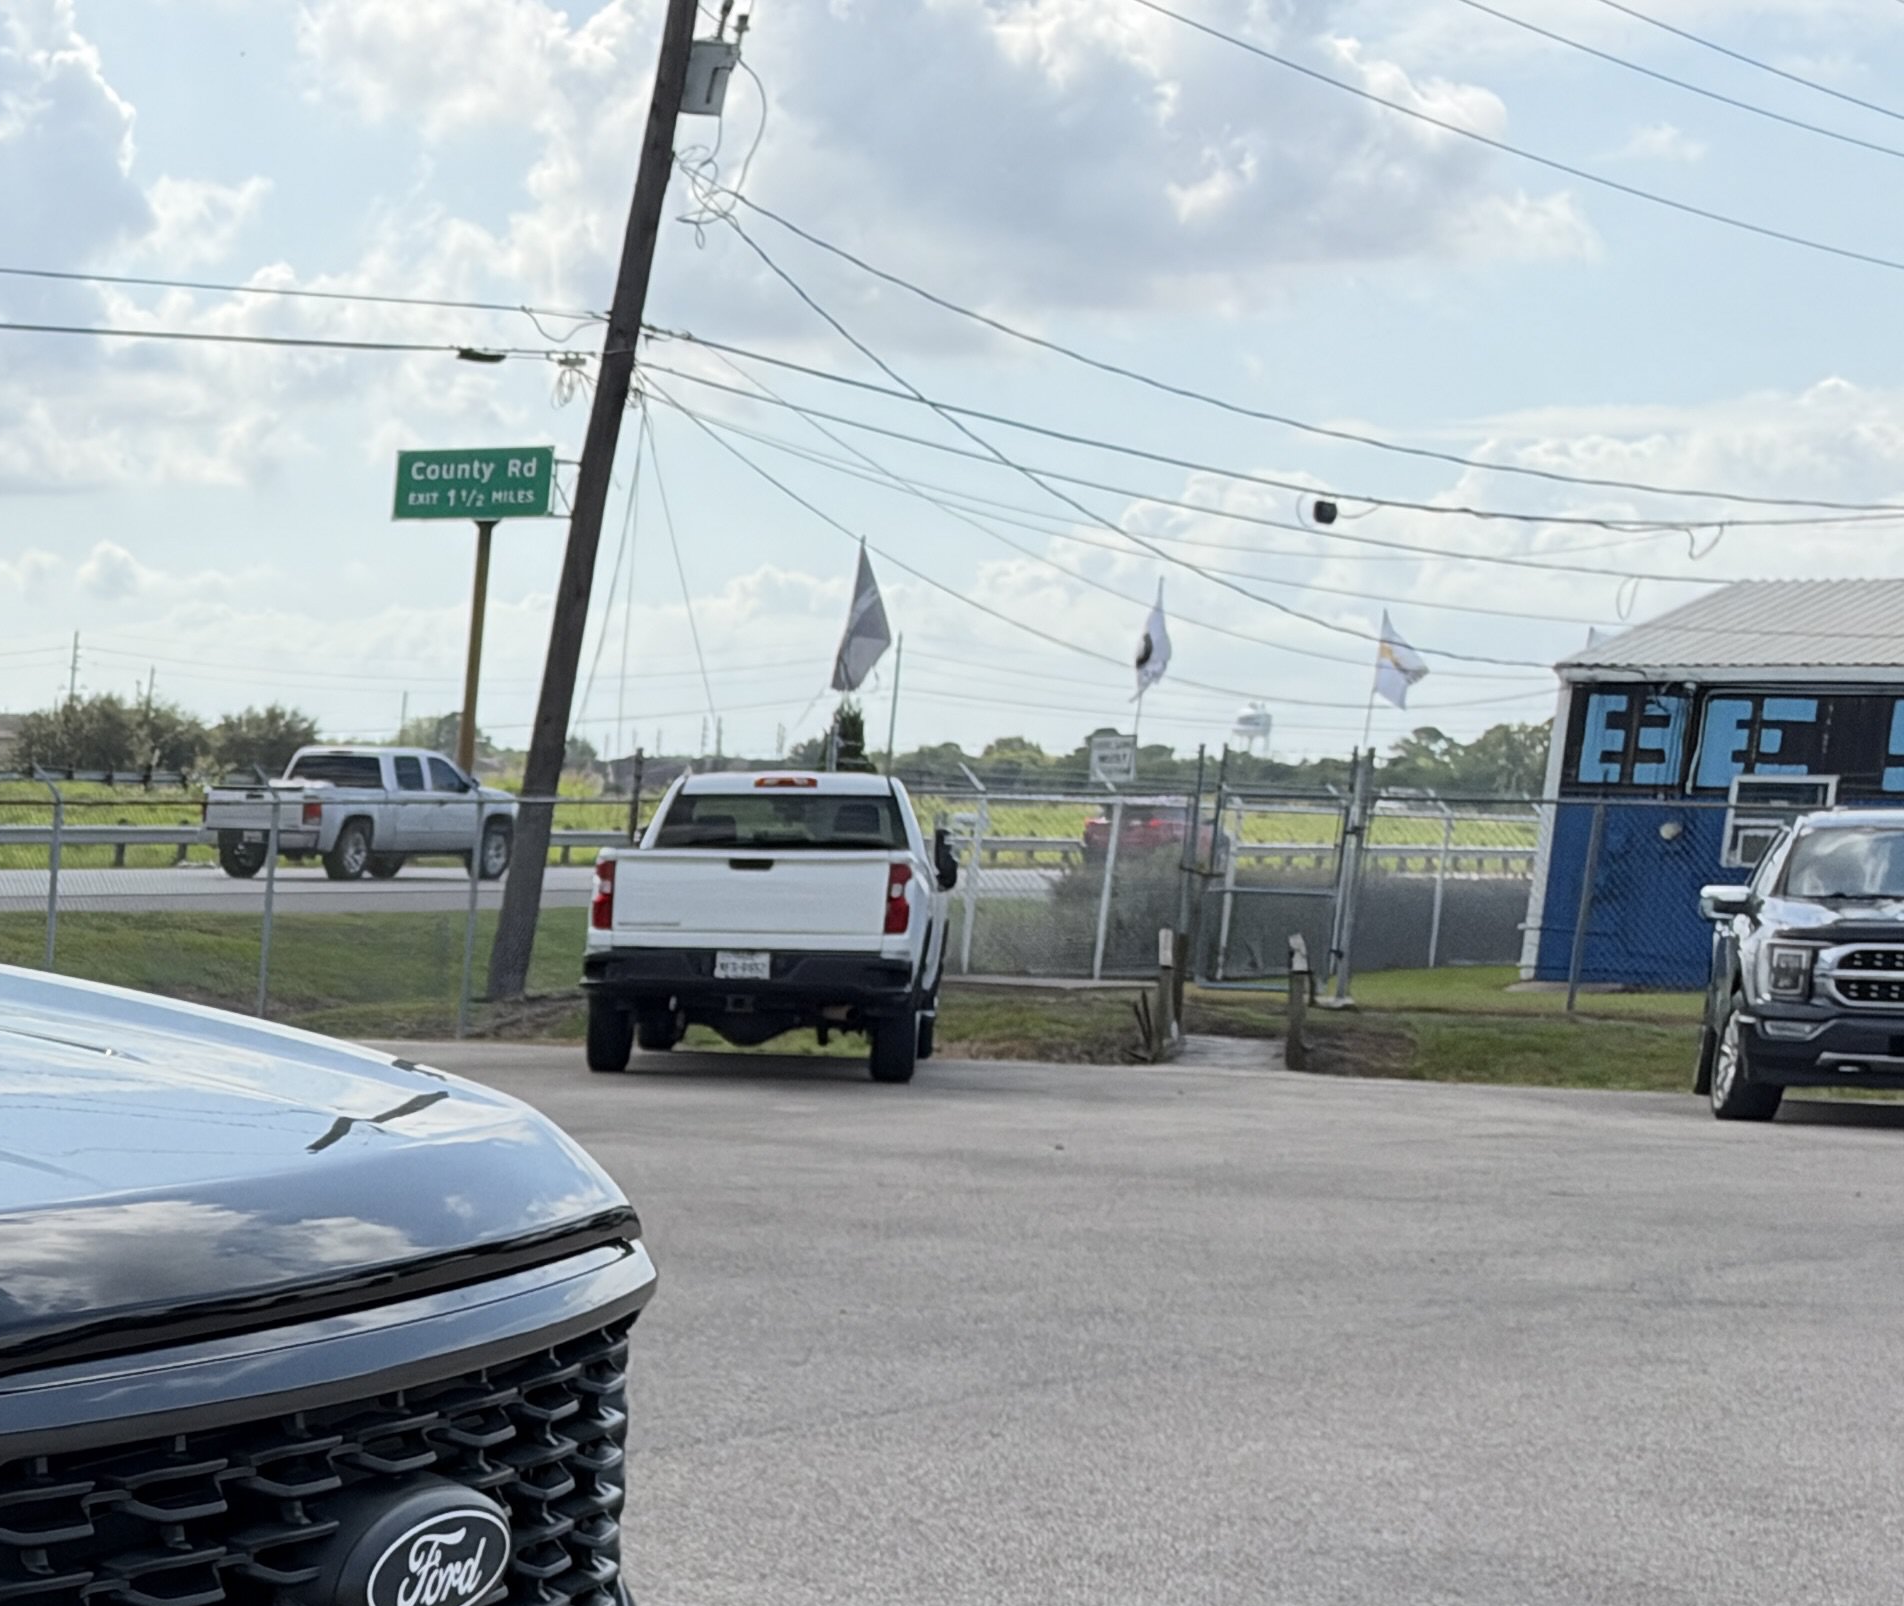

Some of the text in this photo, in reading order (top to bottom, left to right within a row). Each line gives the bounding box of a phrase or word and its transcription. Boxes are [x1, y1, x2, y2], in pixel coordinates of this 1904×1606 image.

[411, 457, 537, 484] County Rd
[408, 491, 439, 506] EXIT
[491, 489, 535, 505] MILES
